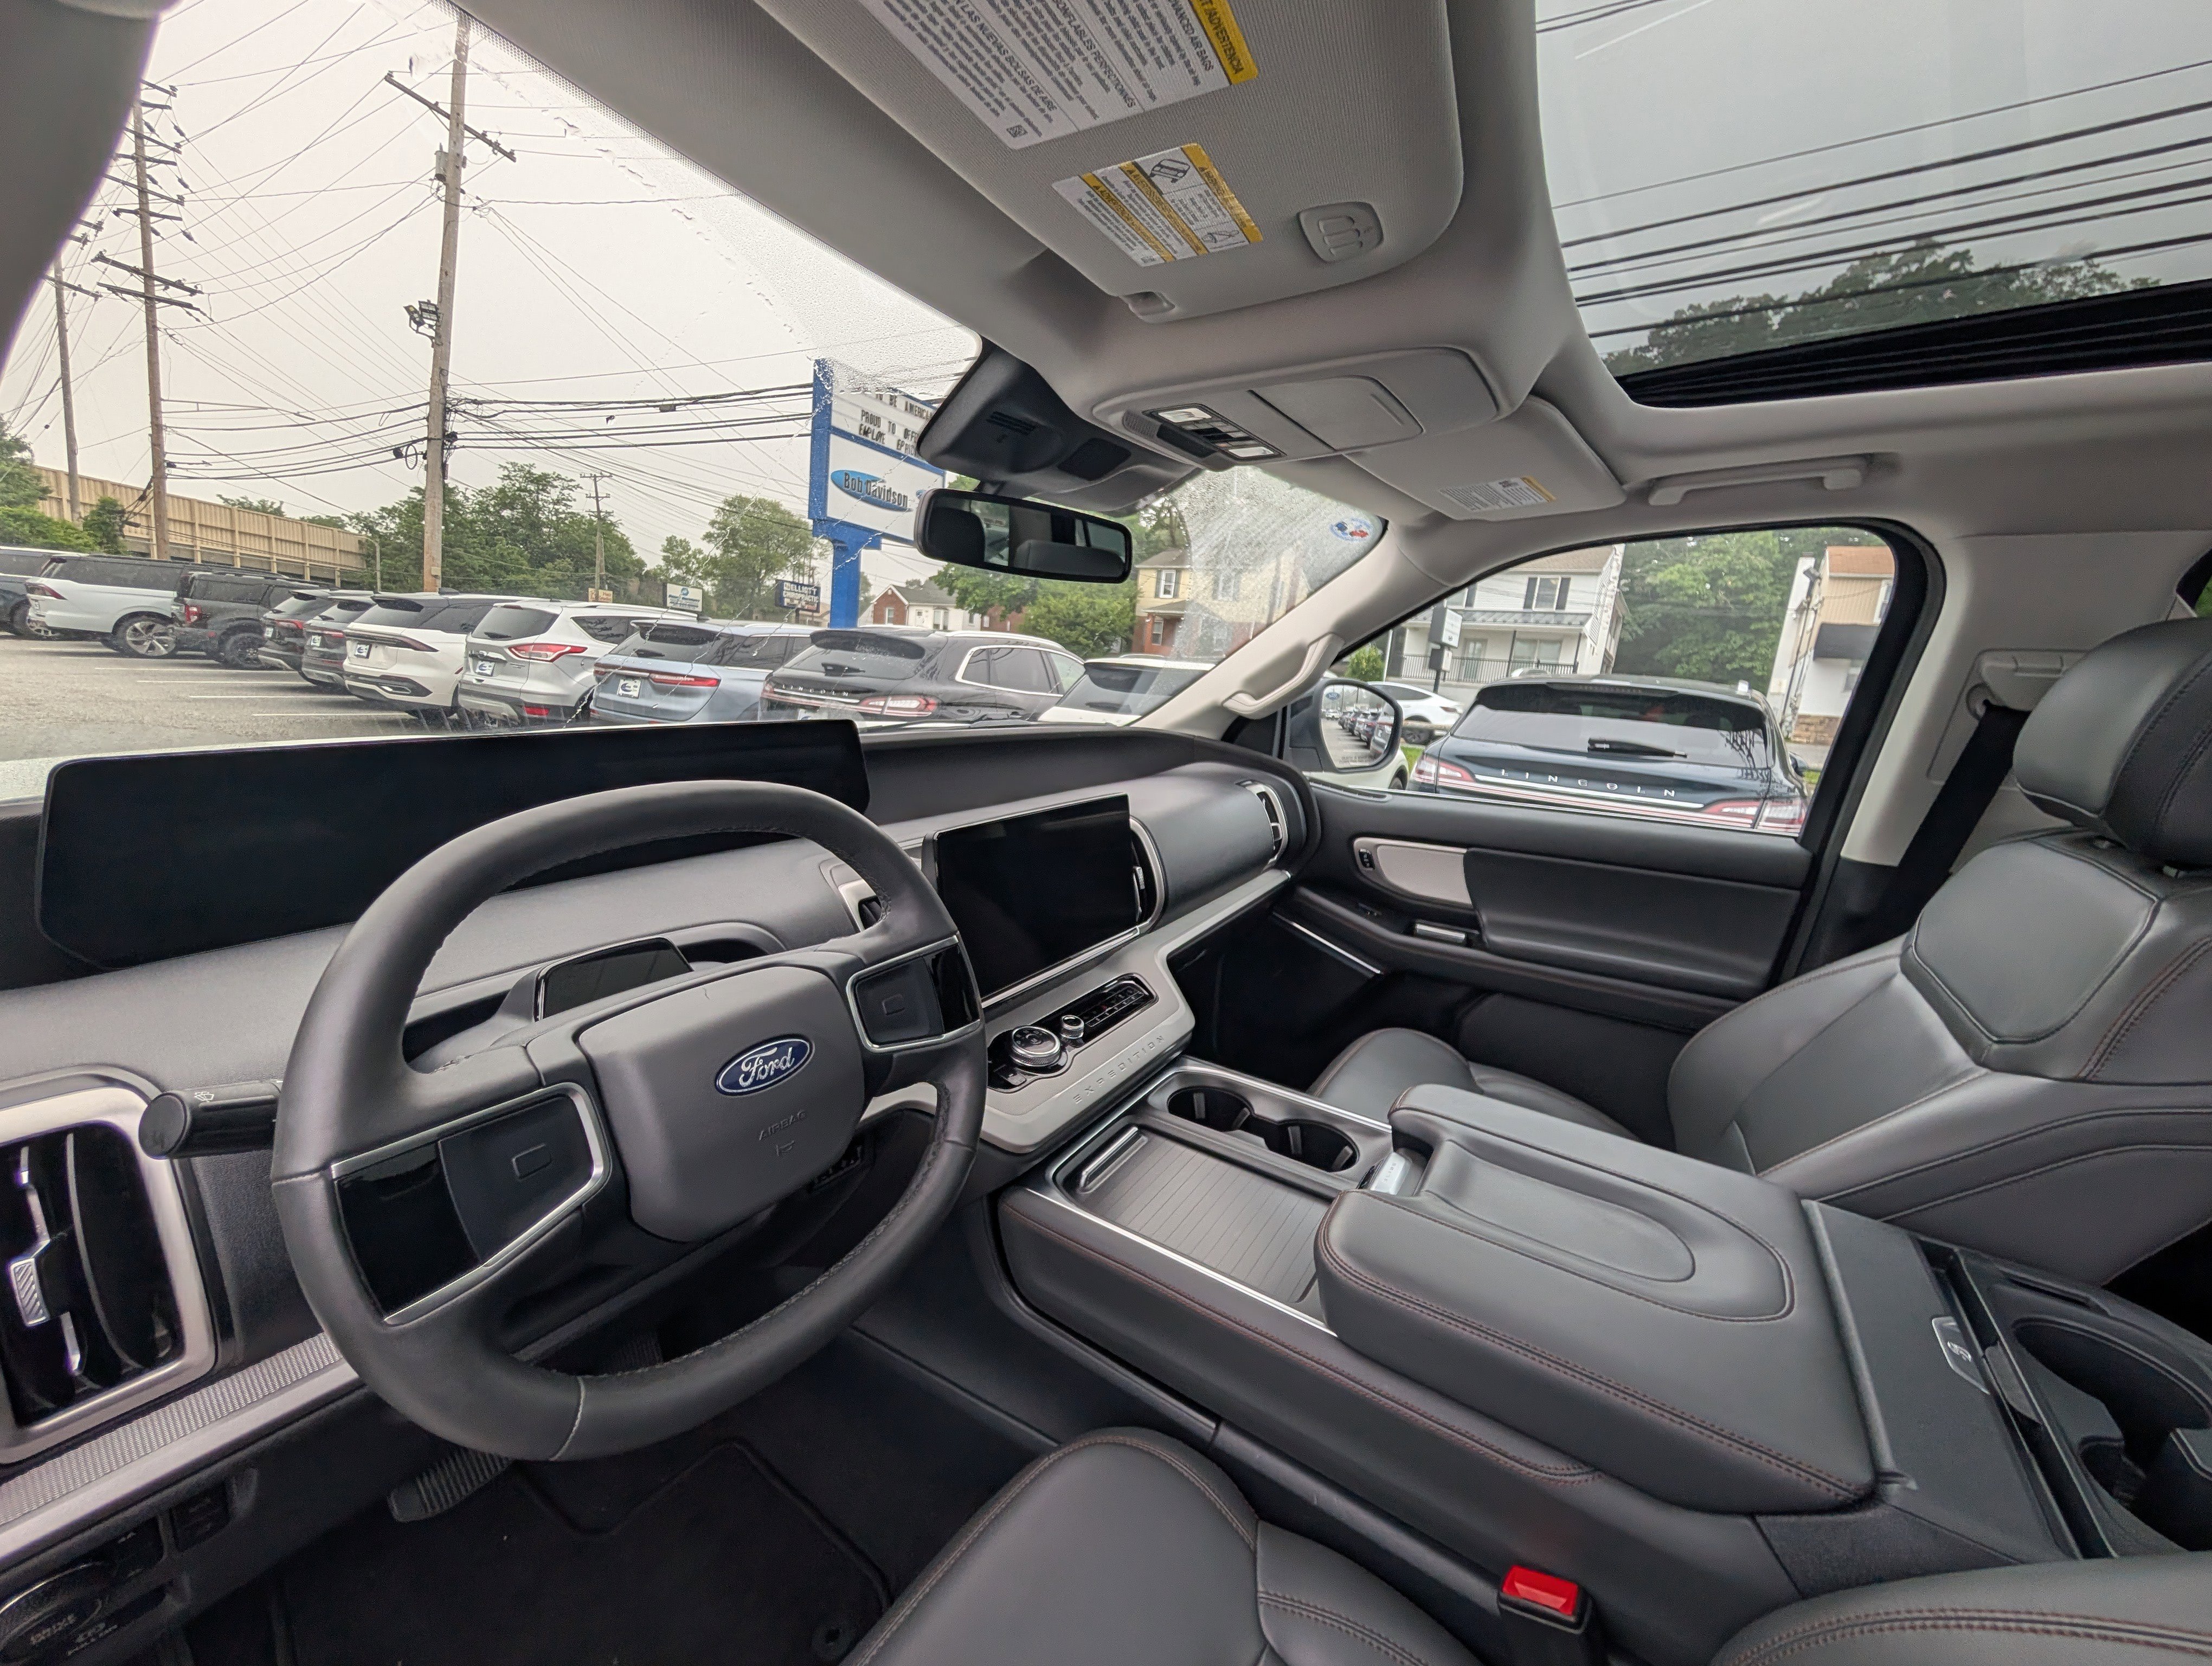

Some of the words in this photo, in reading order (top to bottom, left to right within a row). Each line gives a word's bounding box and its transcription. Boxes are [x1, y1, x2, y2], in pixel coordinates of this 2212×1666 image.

[961, 4, 980, 22] LAS
[978, 23, 1008, 55] NUEVAS
[1005, 56, 1034, 85] BOLSAS
[1031, 85, 1043, 95] DE
[1039, 96, 1057, 111] AIRE
[1189, 36, 1203, 49] AIR
[1197, 49, 1213, 71] BAGS
[861, 409, 881, 428] PROUD
[888, 421, 896, 434] TO
[904, 428, 918, 444] OFFE
[844, 472, 863, 493] Bob
[866, 479, 909, 508] Davidson
[1501, 768, 1676, 798] LINCOLN
[738, 1047, 795, 1087] Ford
[1073, 1035, 1165, 1104] EXPEDITION
[759, 1110, 807, 1141] AIRBAG
